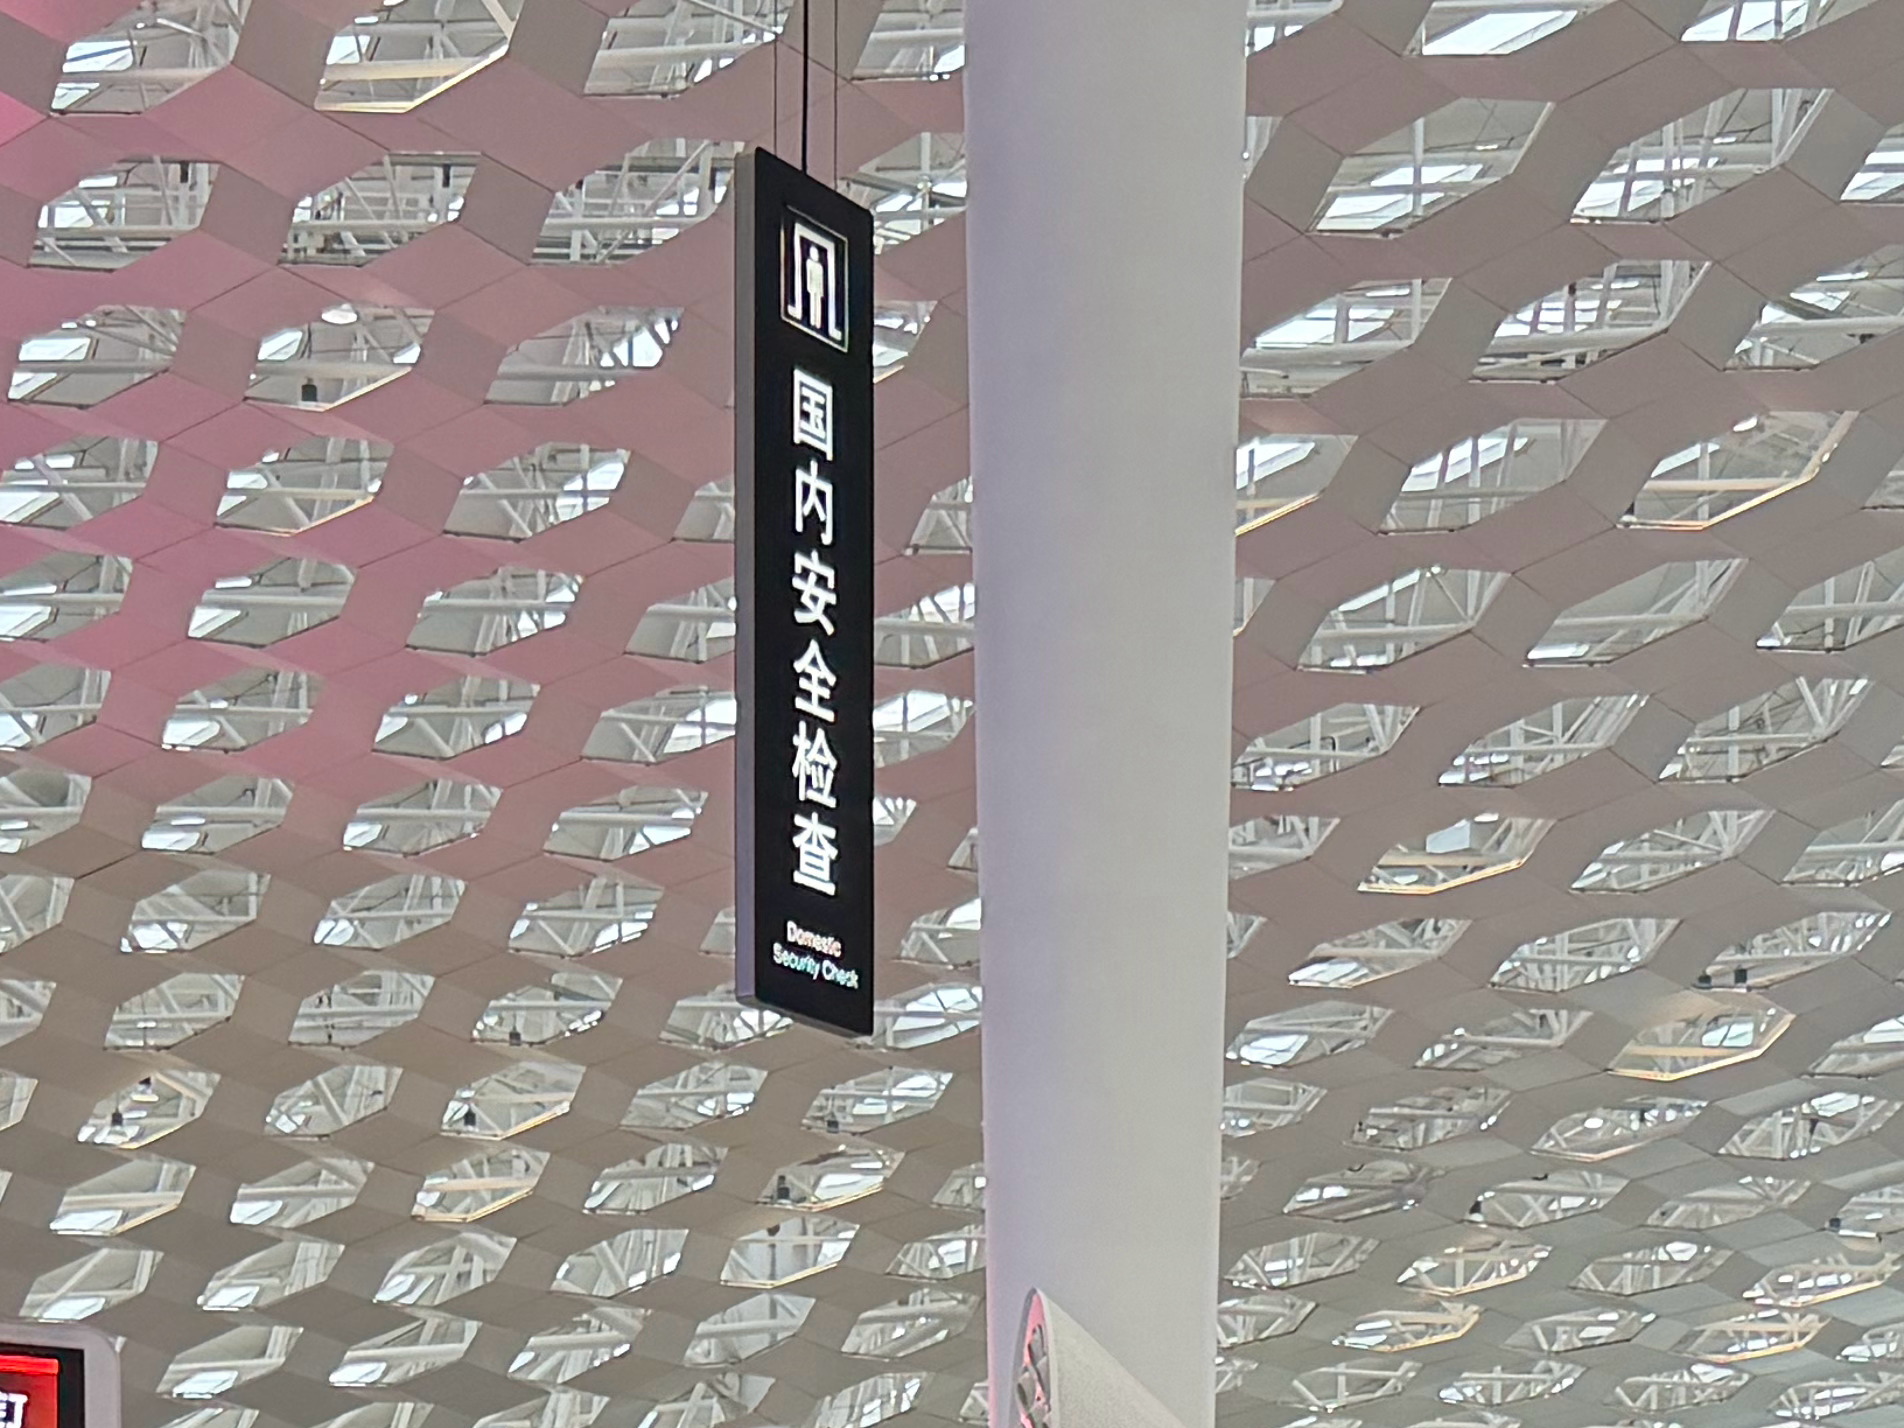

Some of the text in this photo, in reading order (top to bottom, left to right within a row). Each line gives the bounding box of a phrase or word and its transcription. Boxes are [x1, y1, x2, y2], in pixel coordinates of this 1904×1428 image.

[791, 368, 838, 897] 国内安全检查
[786, 920, 842, 957] Domestic
[773, 942, 859, 989] Security Check
